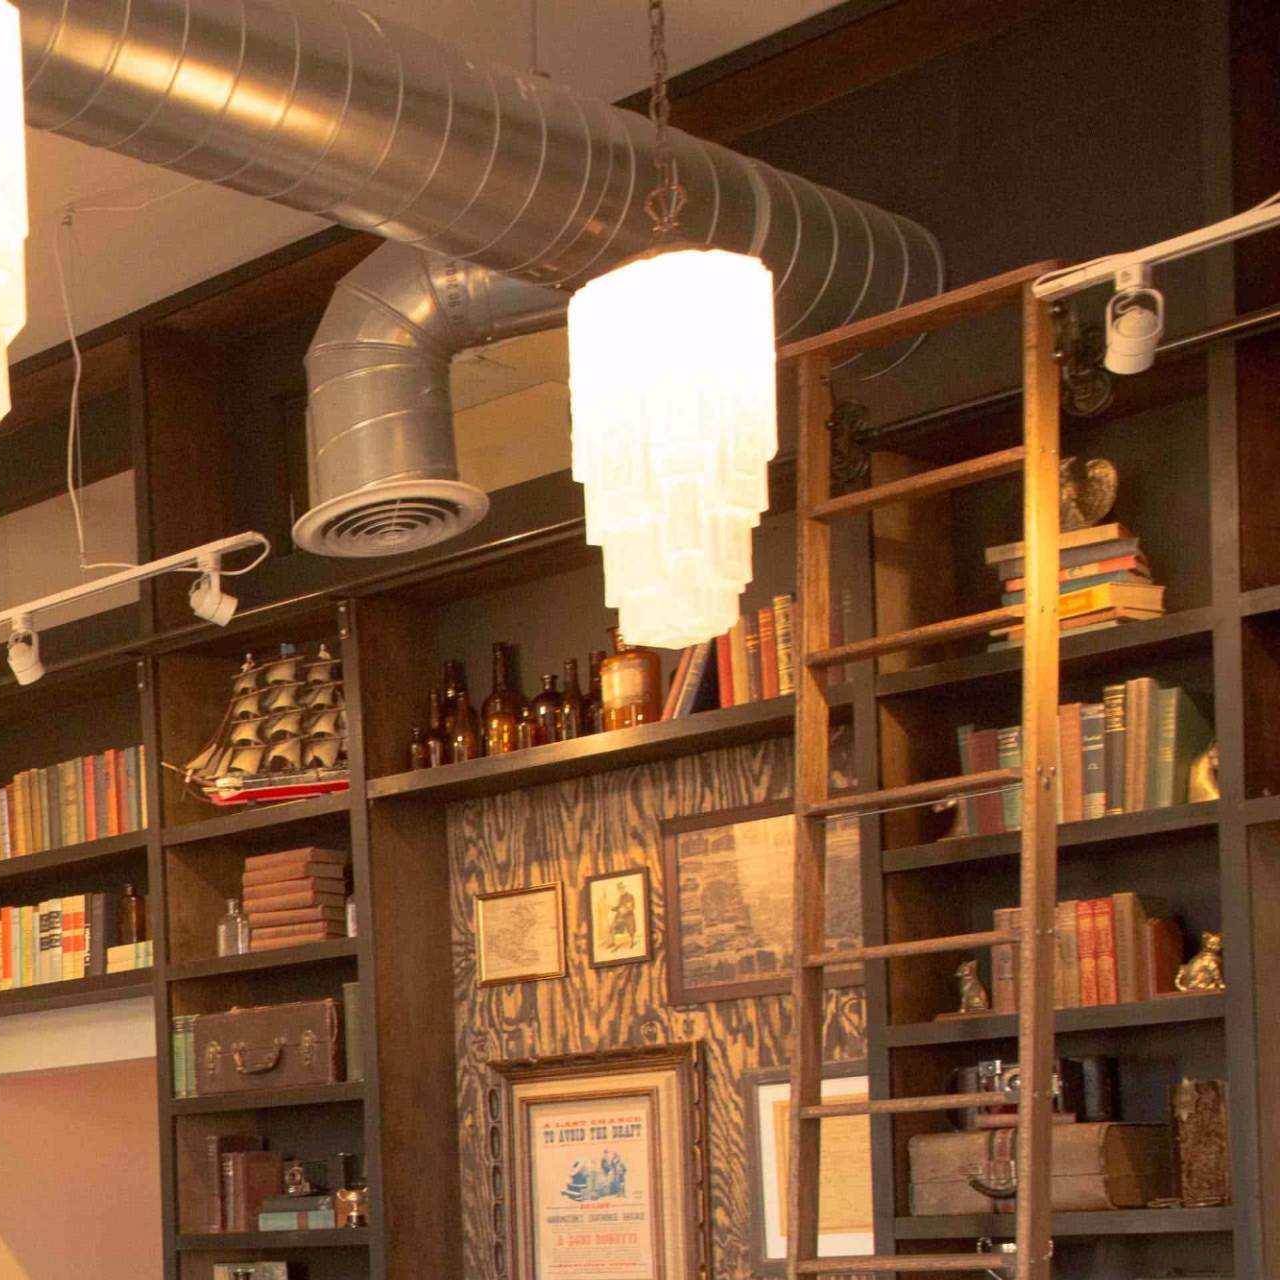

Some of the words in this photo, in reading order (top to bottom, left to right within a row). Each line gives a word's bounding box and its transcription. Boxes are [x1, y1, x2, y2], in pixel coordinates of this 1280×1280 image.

[544, 1130, 555, 1143] TO
[559, 1128, 585, 1143] AVOID
[590, 1126, 607, 1140] THE
[613, 1124, 641, 1138] DRAFT
